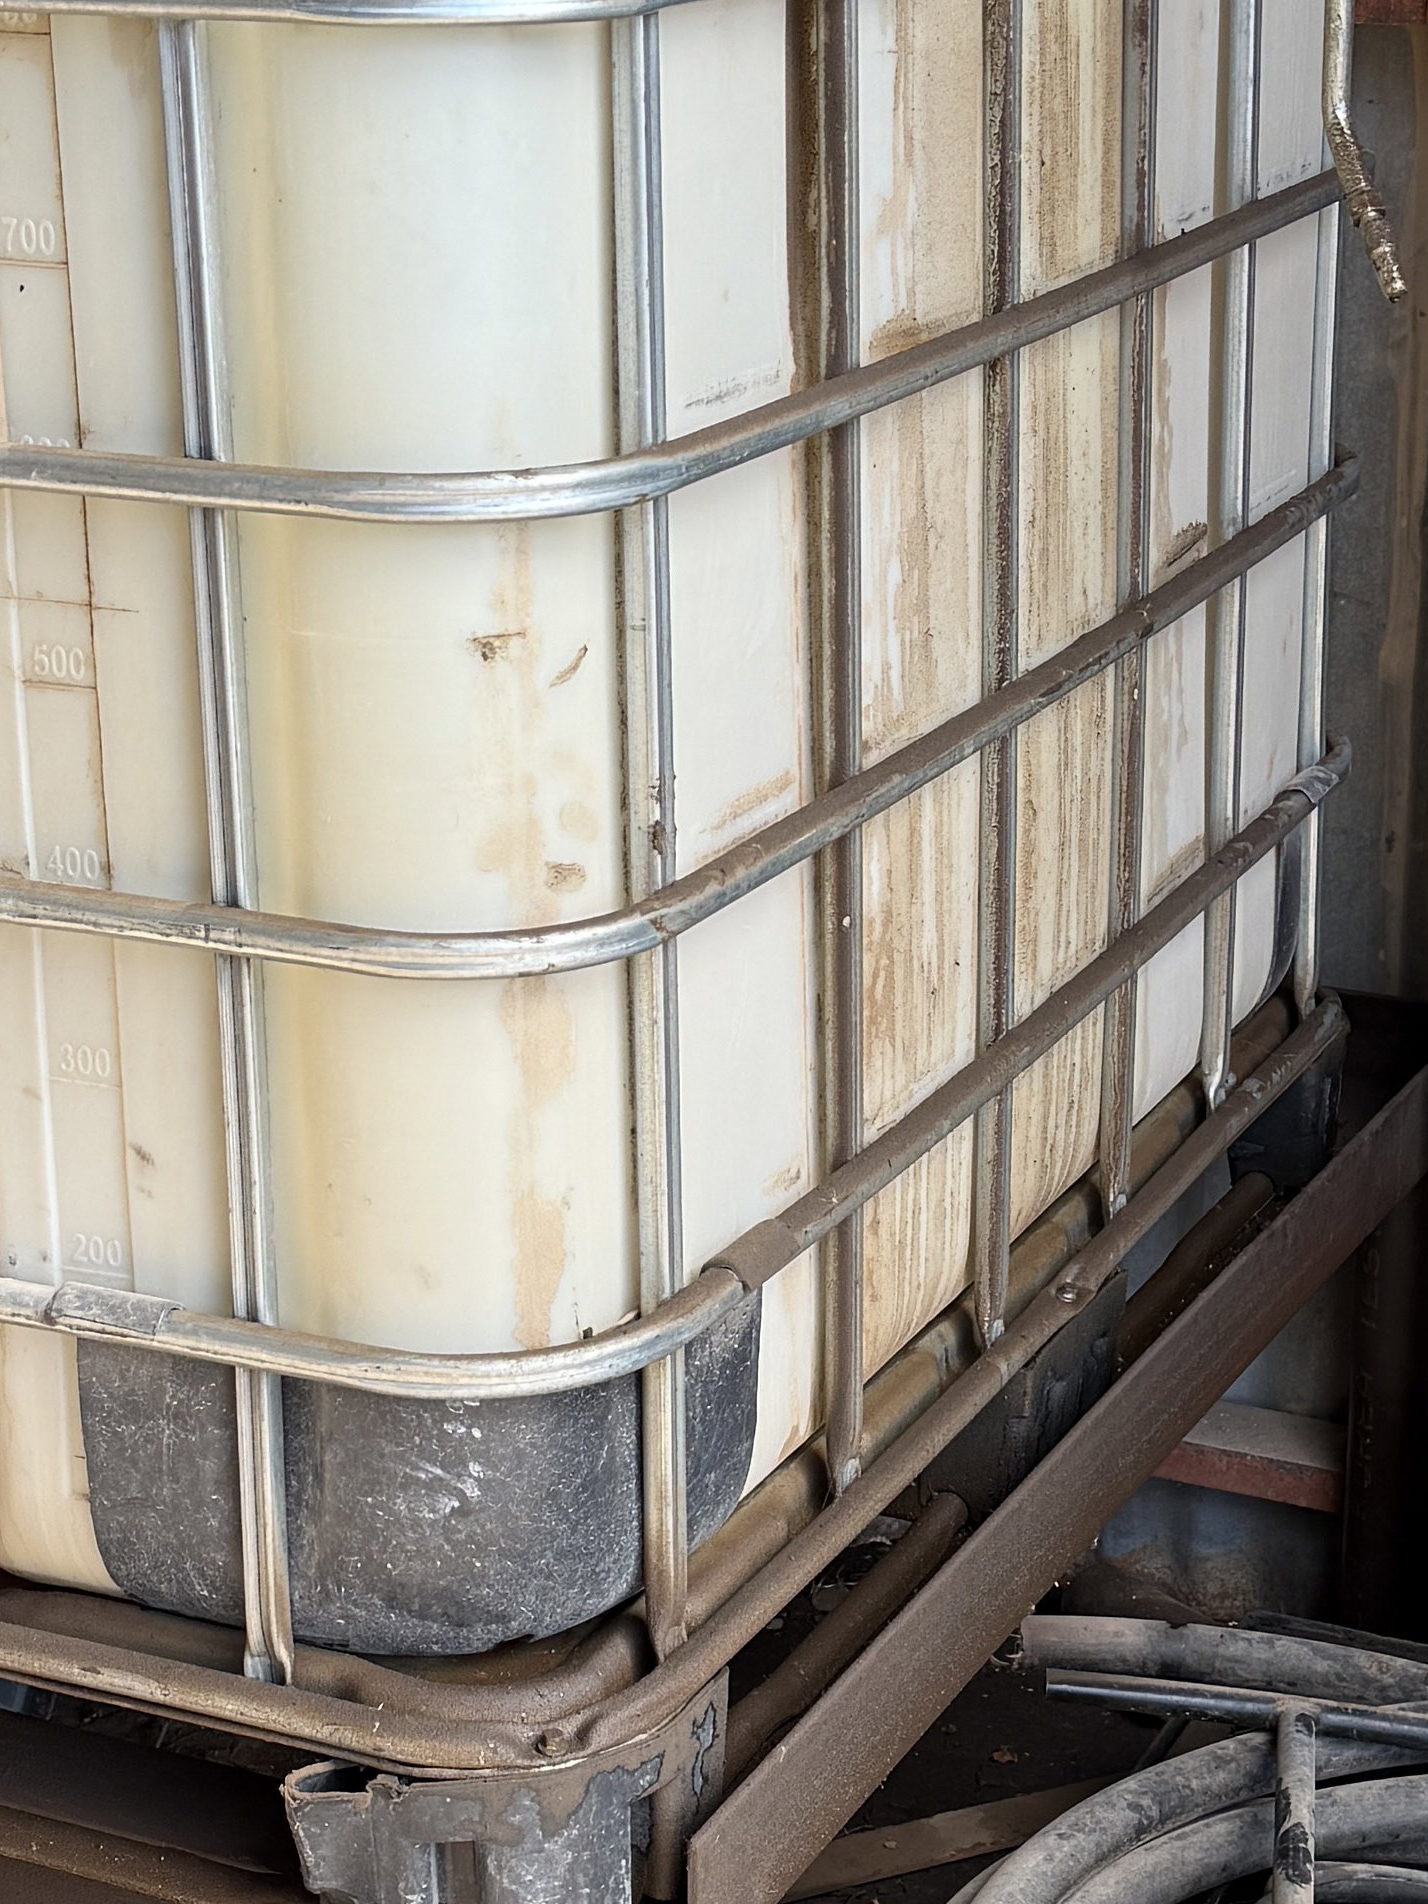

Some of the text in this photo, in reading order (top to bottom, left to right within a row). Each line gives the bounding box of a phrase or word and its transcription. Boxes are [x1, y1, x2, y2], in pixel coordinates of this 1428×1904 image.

[0, 215, 57, 257] 700
[31, 642, 88, 683] 500
[45, 844, 101, 881] 400
[59, 1042, 112, 1079] 300
[72, 1232, 123, 1267] 200
